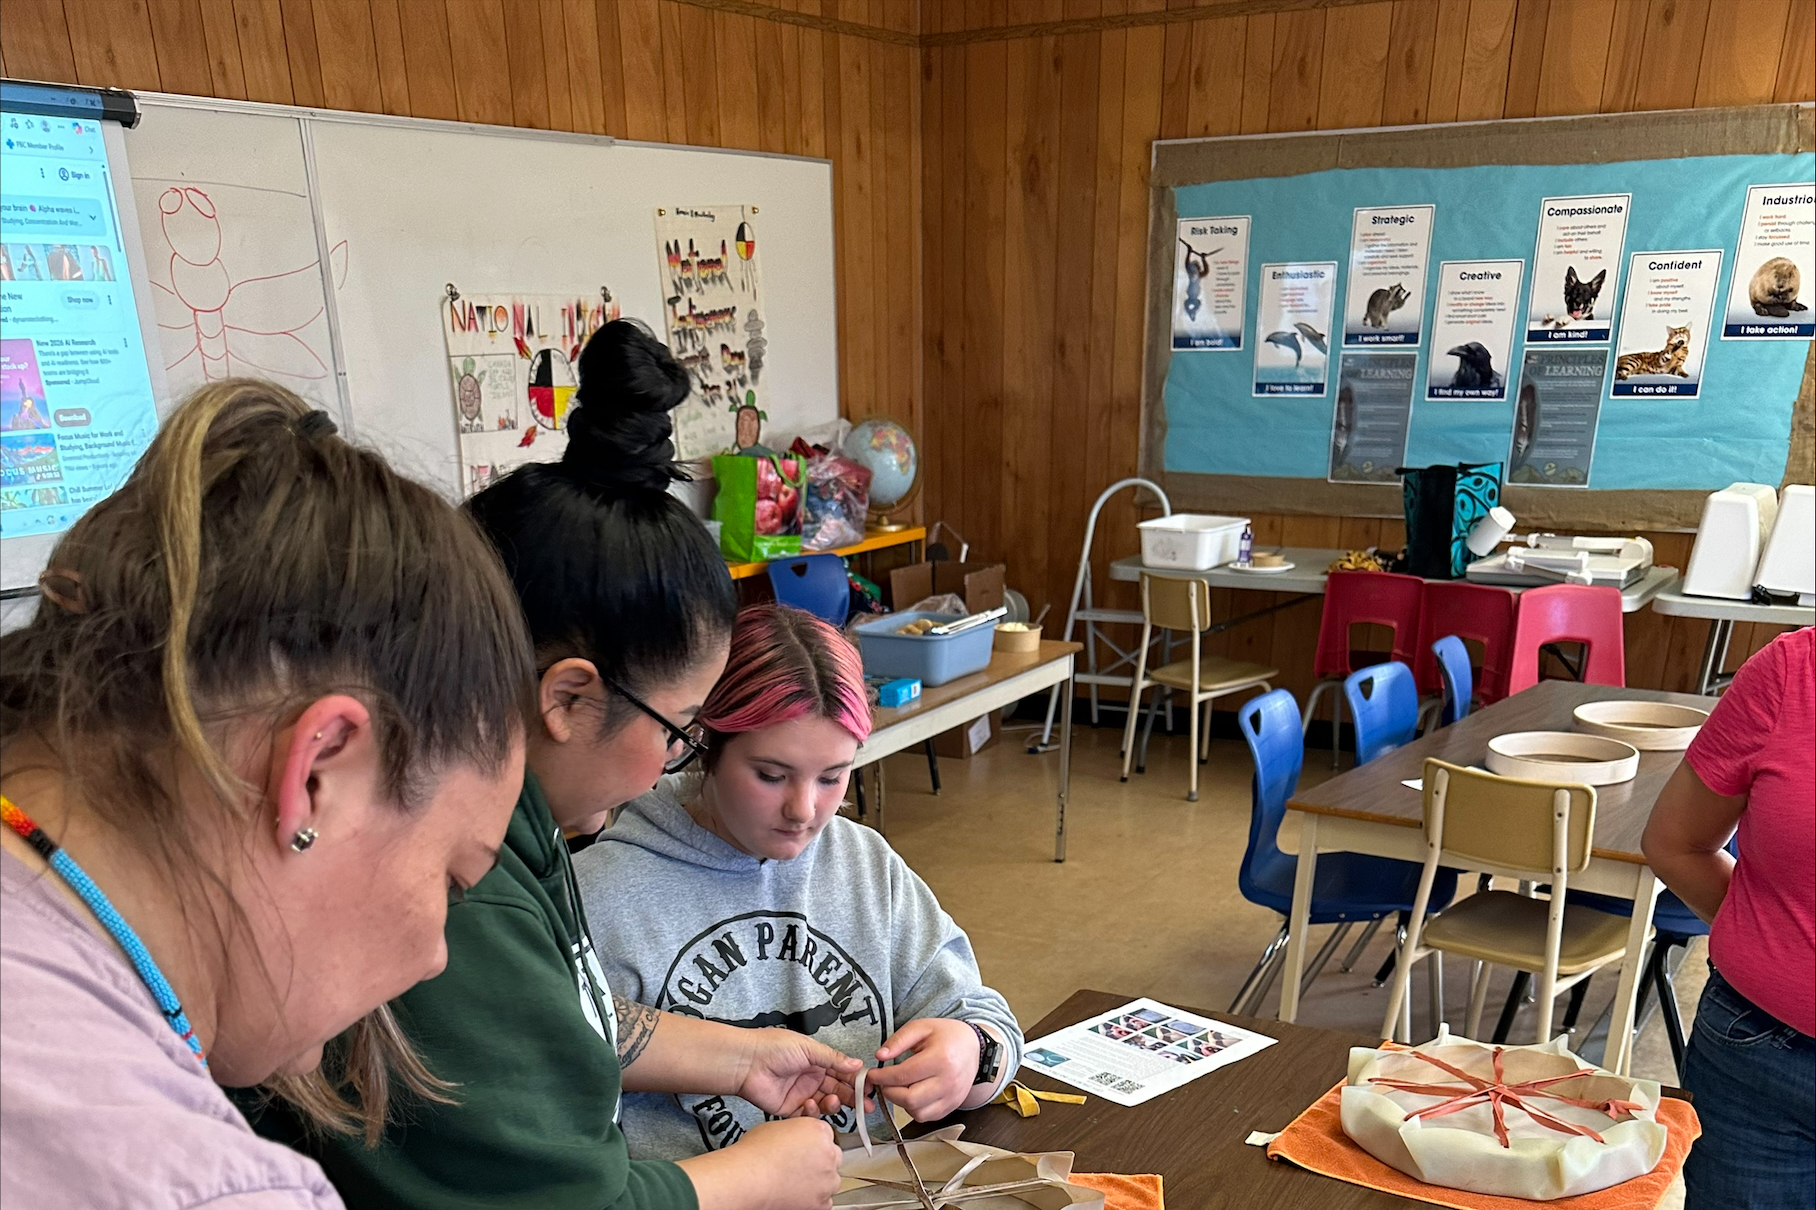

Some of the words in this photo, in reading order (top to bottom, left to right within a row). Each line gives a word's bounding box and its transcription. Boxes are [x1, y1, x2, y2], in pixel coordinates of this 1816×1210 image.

[71, 171, 83, 180] Sign
[1762, 195, 1816, 205] Industrio
[1547, 205, 1623, 217] Compassionate
[1371, 215, 1415, 225] Strategic
[1191, 227, 1208, 235] Risk
[1210, 226, 1238, 236] Taking
[1648, 260, 1702, 271] Confident
[1272, 271, 1325, 280] Enthusiastic
[1459, 271, 1502, 281] Creative
[450, 299, 548, 338] NATIONAL
[1741, 326, 1746, 334] I
[1746, 326, 1765, 334] take
[1767, 326, 1798, 334] action!
[1539, 355, 1605, 365] PRINCIPLES
[1360, 368, 1413, 380] LEARNING
[1545, 365, 1603, 377] LEARNING
[1270, 384, 1284, 392] love
[1285, 384, 1292, 392] to
[1293, 384, 1314, 392] learn!
[1481, 389, 1499, 397] way!
[1656, 385, 1667, 393] do
[85, 441, 115, 449] Background
[28, 464, 58, 473] MUSIC
[755, 922, 879, 1027] PARENT
